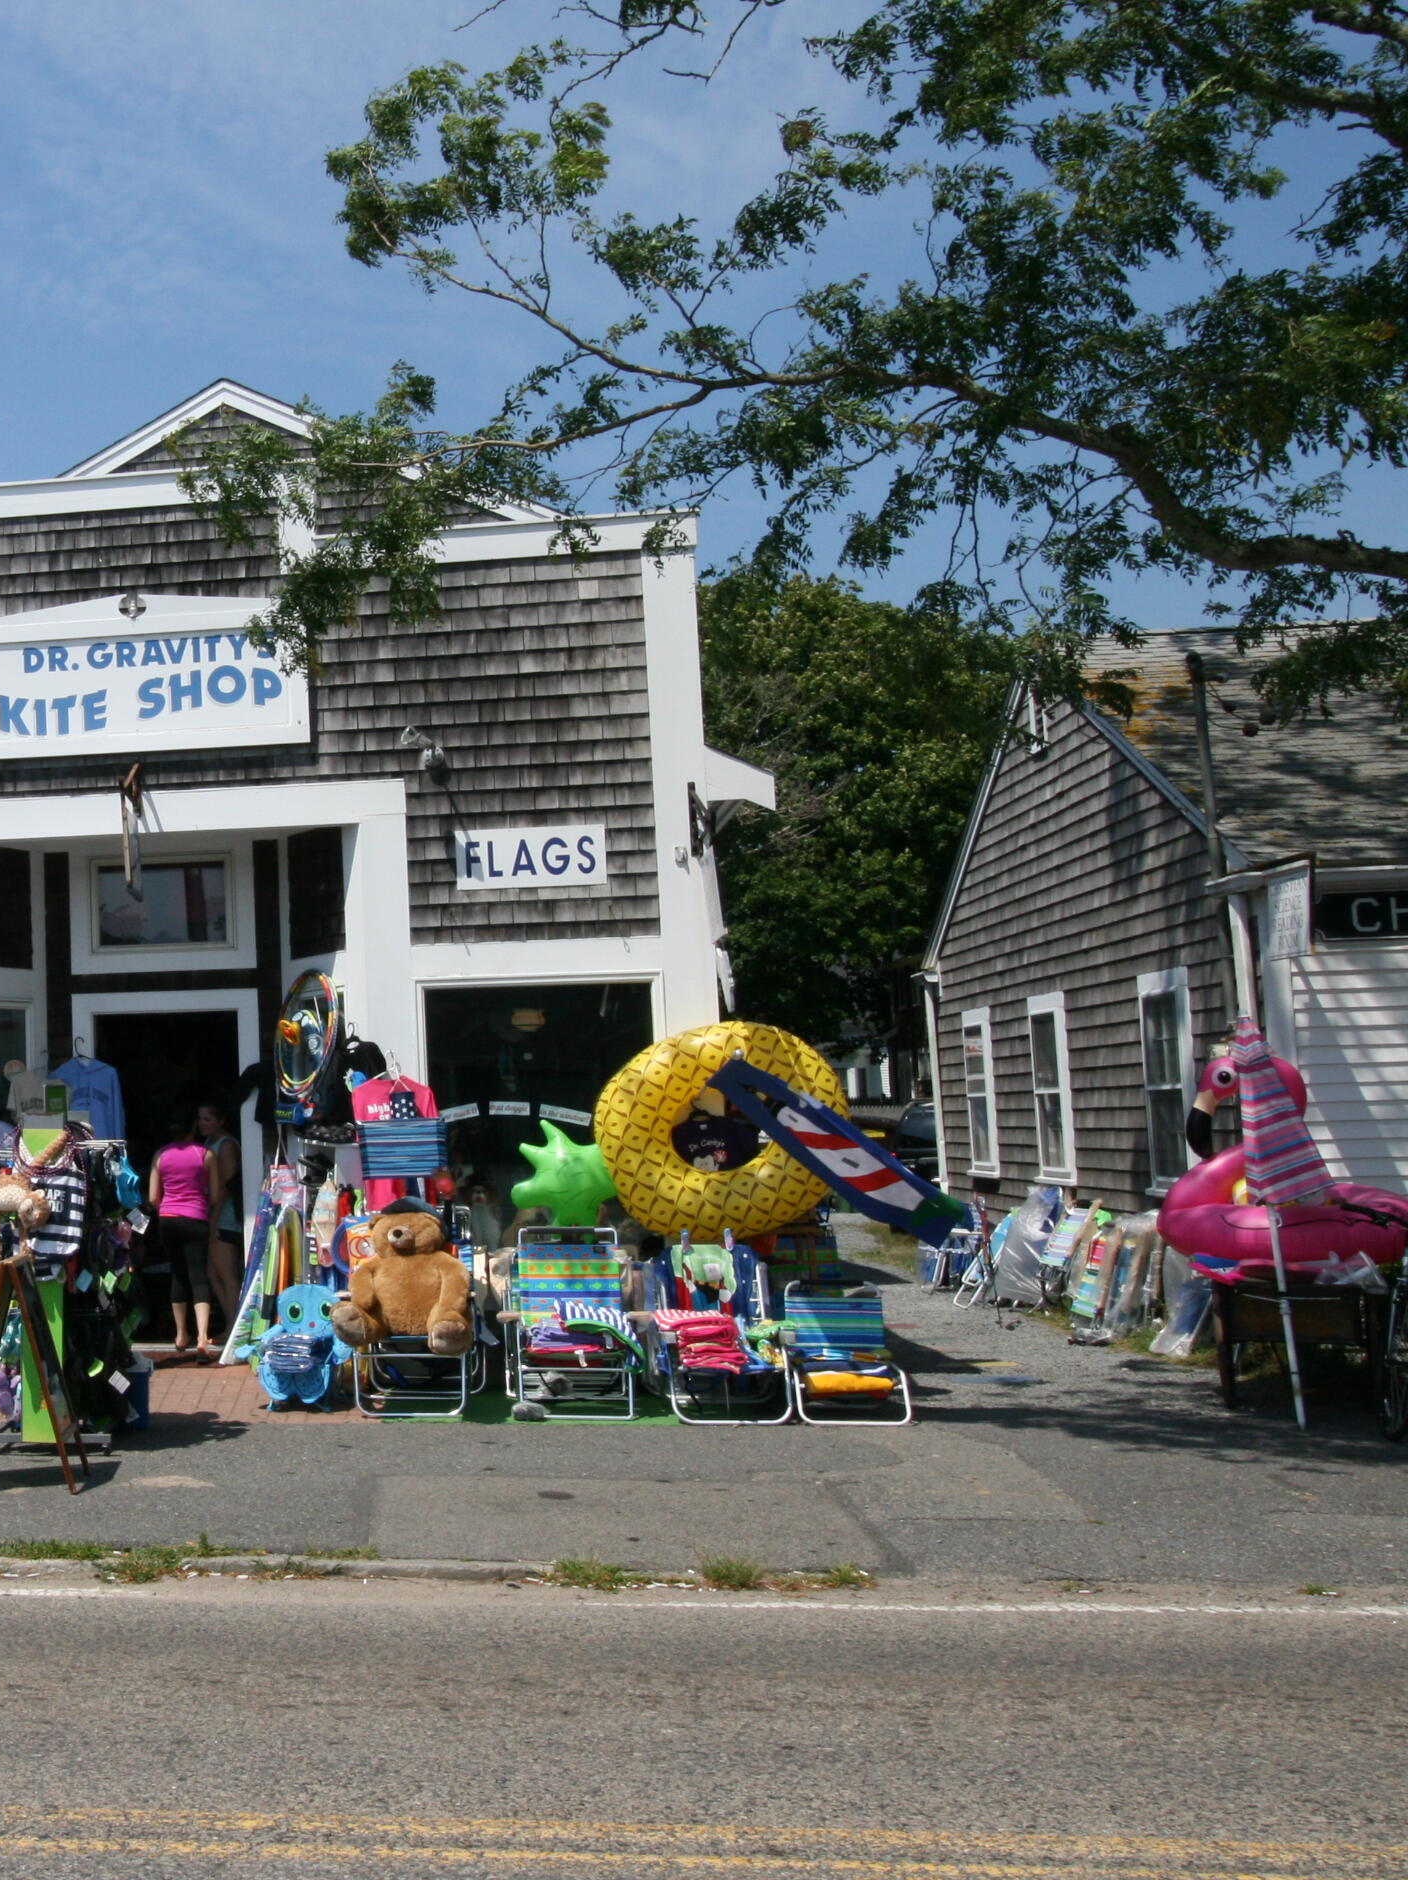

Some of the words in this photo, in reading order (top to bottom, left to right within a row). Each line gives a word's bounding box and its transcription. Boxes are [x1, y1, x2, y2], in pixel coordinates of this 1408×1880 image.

[22, 646, 79, 673] DR.
[86, 632, 277, 669] GRAVITYS
[137, 664, 283, 721] SHOP
[464, 835, 596, 879] FLAGS
[1351, 896, 1408, 932] CH
[45, 1188, 67, 1202] APE
